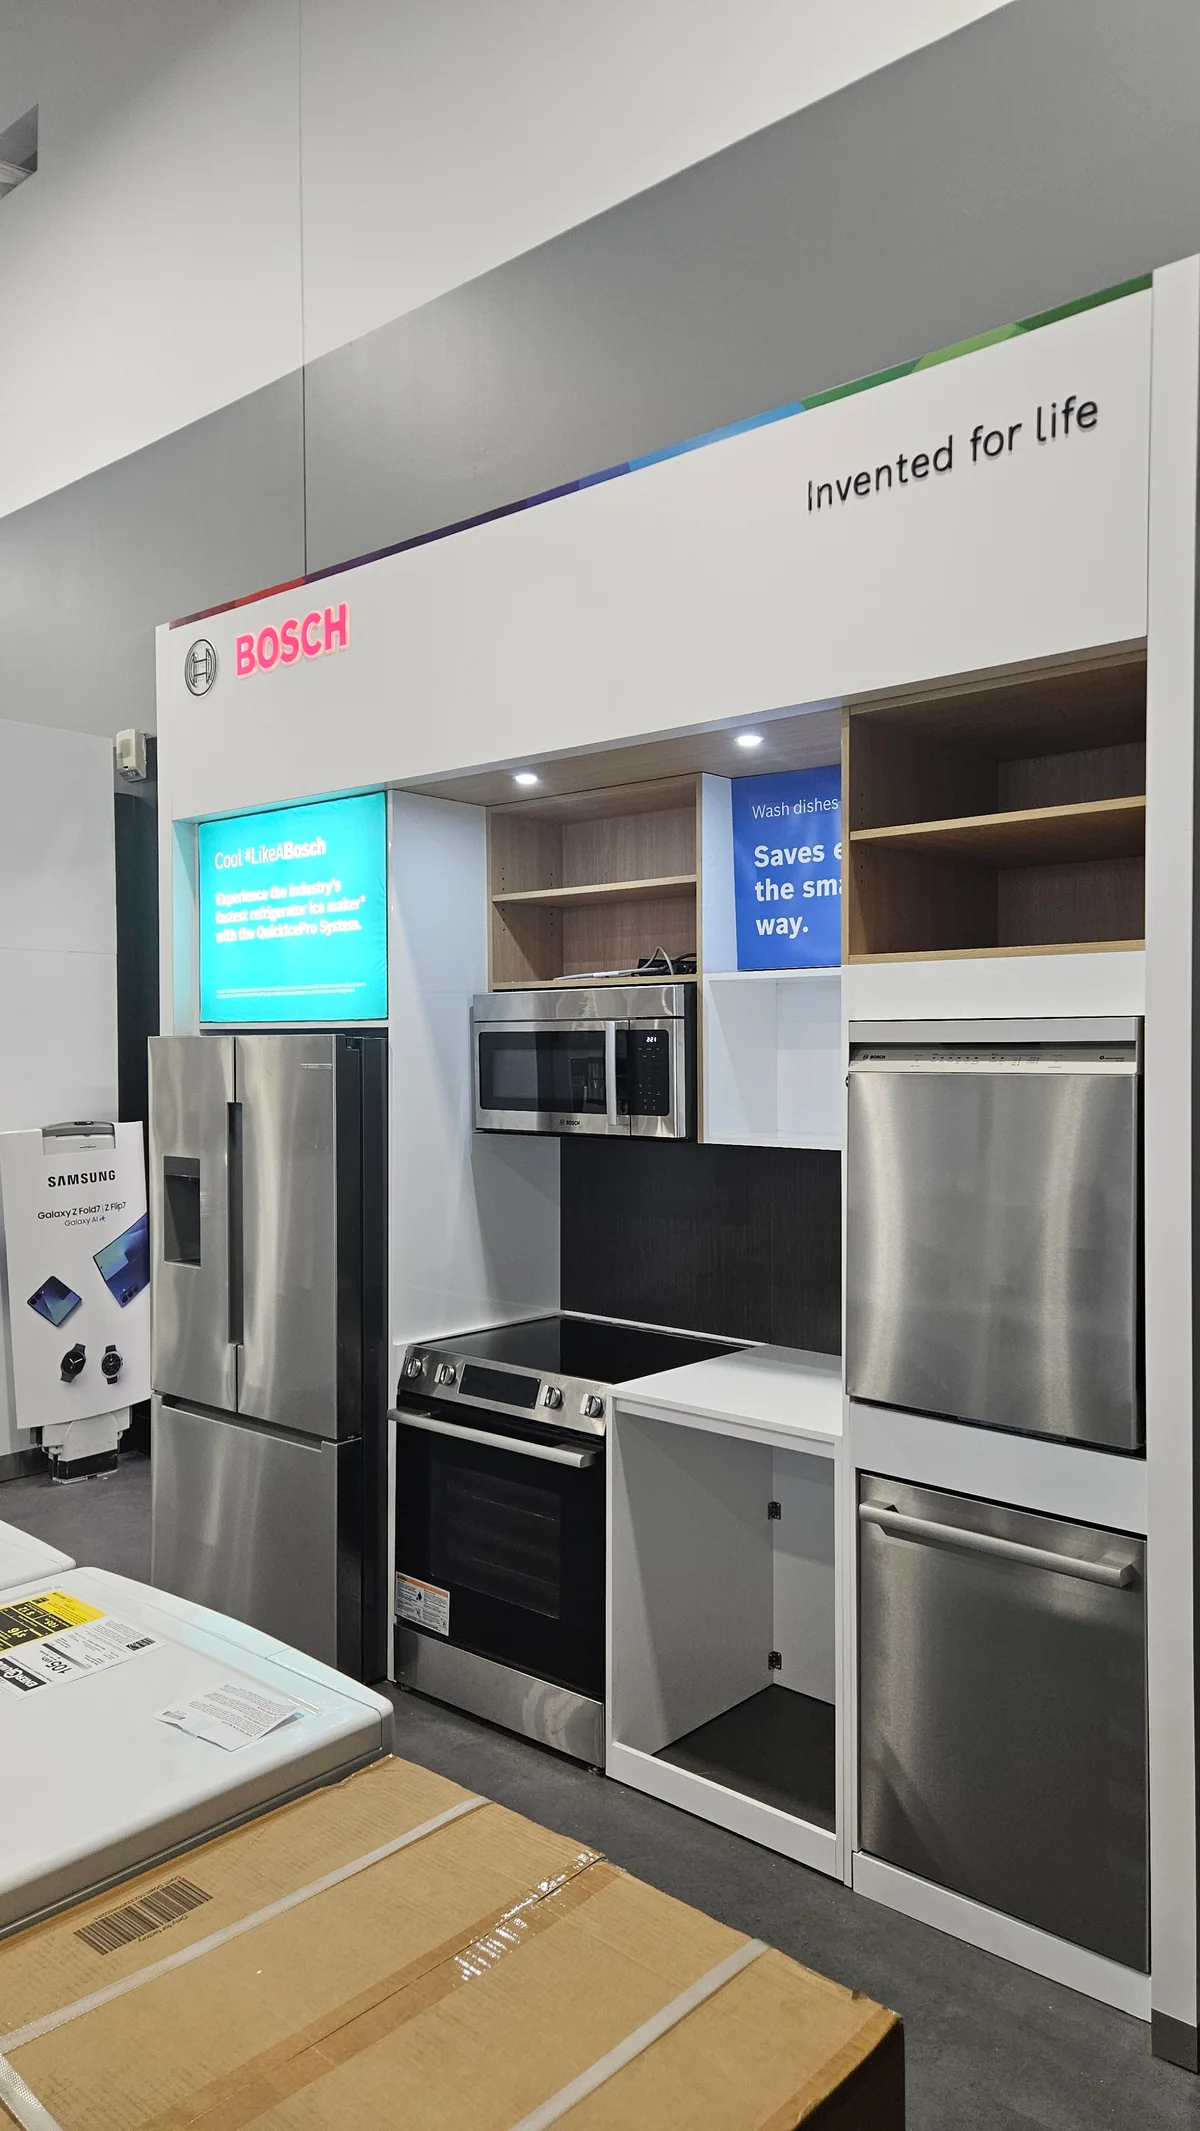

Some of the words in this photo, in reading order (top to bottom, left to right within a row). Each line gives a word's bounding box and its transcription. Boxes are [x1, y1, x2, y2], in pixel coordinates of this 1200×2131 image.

[807, 434, 953, 512] Invented
[970, 424, 1022, 462] for
[1036, 395, 1098, 442] life
[235, 602, 348, 679] BOSCH
[752, 802, 790, 819] Wash
[793, 798, 839, 815] dishes
[214, 848, 243, 870] Cool
[244, 835, 327, 865] #LikeABosch
[754, 844, 826, 868] Saves
[215, 889, 269, 907] Experience
[270, 885, 288, 900] the
[288, 877, 342, 897] industry's
[754, 878, 795, 902] the
[802, 878, 842, 898] sm
[215, 909, 249, 925] fastest
[249, 905, 308, 923] refrigerator
[308, 900, 325, 915] ice
[215, 928, 237, 943] with
[238, 926, 255, 941] the
[256, 921, 318, 940] QuickIcePro
[755, 916, 809, 939] way.
[47, 1169, 116, 1188] SAMSUNG
[37, 1210, 71, 1219] Galaxy
[72, 1207, 77, 1216] Z
[79, 1204, 101, 1215] Fold7
[110, 1201, 126, 1212] Flip7
[64, 1218, 90, 1226] Galaxy
[45, 1660, 72, 1674] 105
